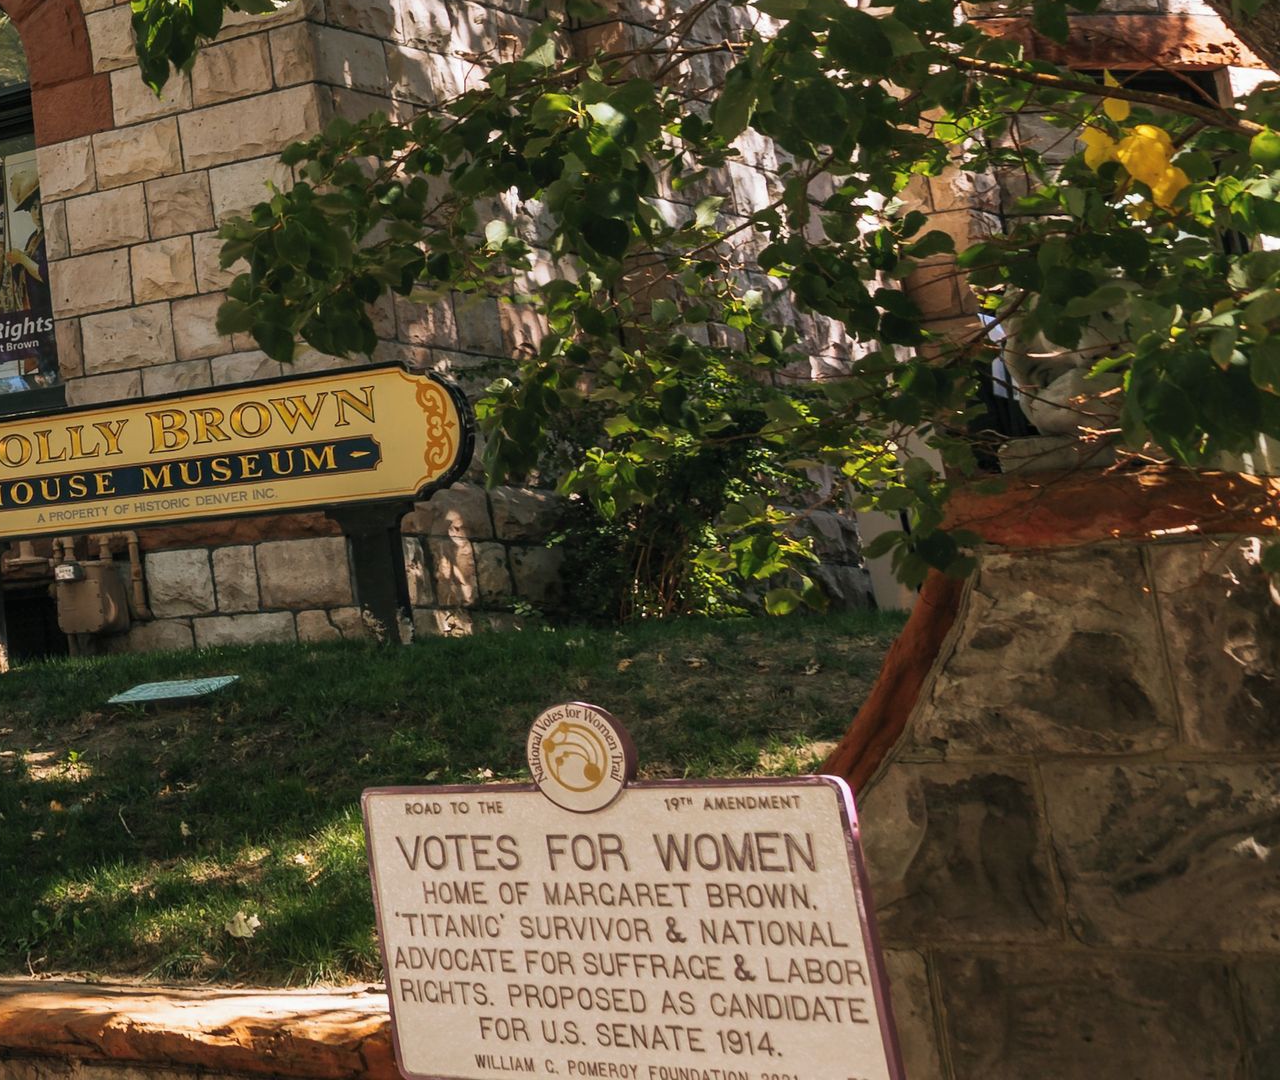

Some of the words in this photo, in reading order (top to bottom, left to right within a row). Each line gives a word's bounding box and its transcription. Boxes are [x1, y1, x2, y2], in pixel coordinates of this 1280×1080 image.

[6, 338, 39, 353] Brown
[145, 385, 376, 455] BROWN
[141, 444, 339, 491] MUSEUM
[37, 513, 46, 524] A
[48, 506, 109, 521] PROPERTY
[113, 503, 130, 516] OF
[133, 497, 190, 513] HISTORIC
[195, 490, 249, 507] DENVER
[252, 487, 279, 501] INC.
[535, 711, 565, 732] Votes
[564, 704, 582, 719] for
[583, 708, 618, 751] Women
[528, 729, 548, 784] National
[609, 751, 624, 784] Trail
[405, 802, 442, 815] ROAD
[449, 801, 470, 815] TO
[477, 801, 504, 814] THE
[663, 796, 694, 812] 19TH
[703, 794, 801, 811] AMENDMENT
[395, 834, 521, 871] VOTES
[545, 833, 630, 871] FOR
[652, 831, 817, 872] WOMEN
[422, 881, 488, 905] HOME
[498, 881, 530, 905] OF
[543, 882, 691, 908] MARGARET
[520, 915, 653, 943] SURVIVOR
[665, 916, 687, 944] &
[700, 919, 849, 948] NATIONAL
[395, 946, 517, 973] ADVOCATE
[524, 950, 576, 975] FOR
[582, 952, 725, 981] SUFFRAGE
[733, 954, 757, 982] &
[764, 956, 868, 986] LABOR
[399, 979, 495, 1007] RIGHTS.
[507, 983, 648, 1014] PROPOSED
[661, 990, 697, 1016] AS
[709, 992, 870, 1025] CANDIDATE
[478, 1016, 531, 1042] FOR
[541, 1019, 587, 1047] U.S.
[596, 1022, 706, 1053] SENATE
[716, 1029, 783, 1058] 1914.
[475, 1054, 536, 1072] WILLIAM
[567, 1059, 638, 1080] POMEROY
